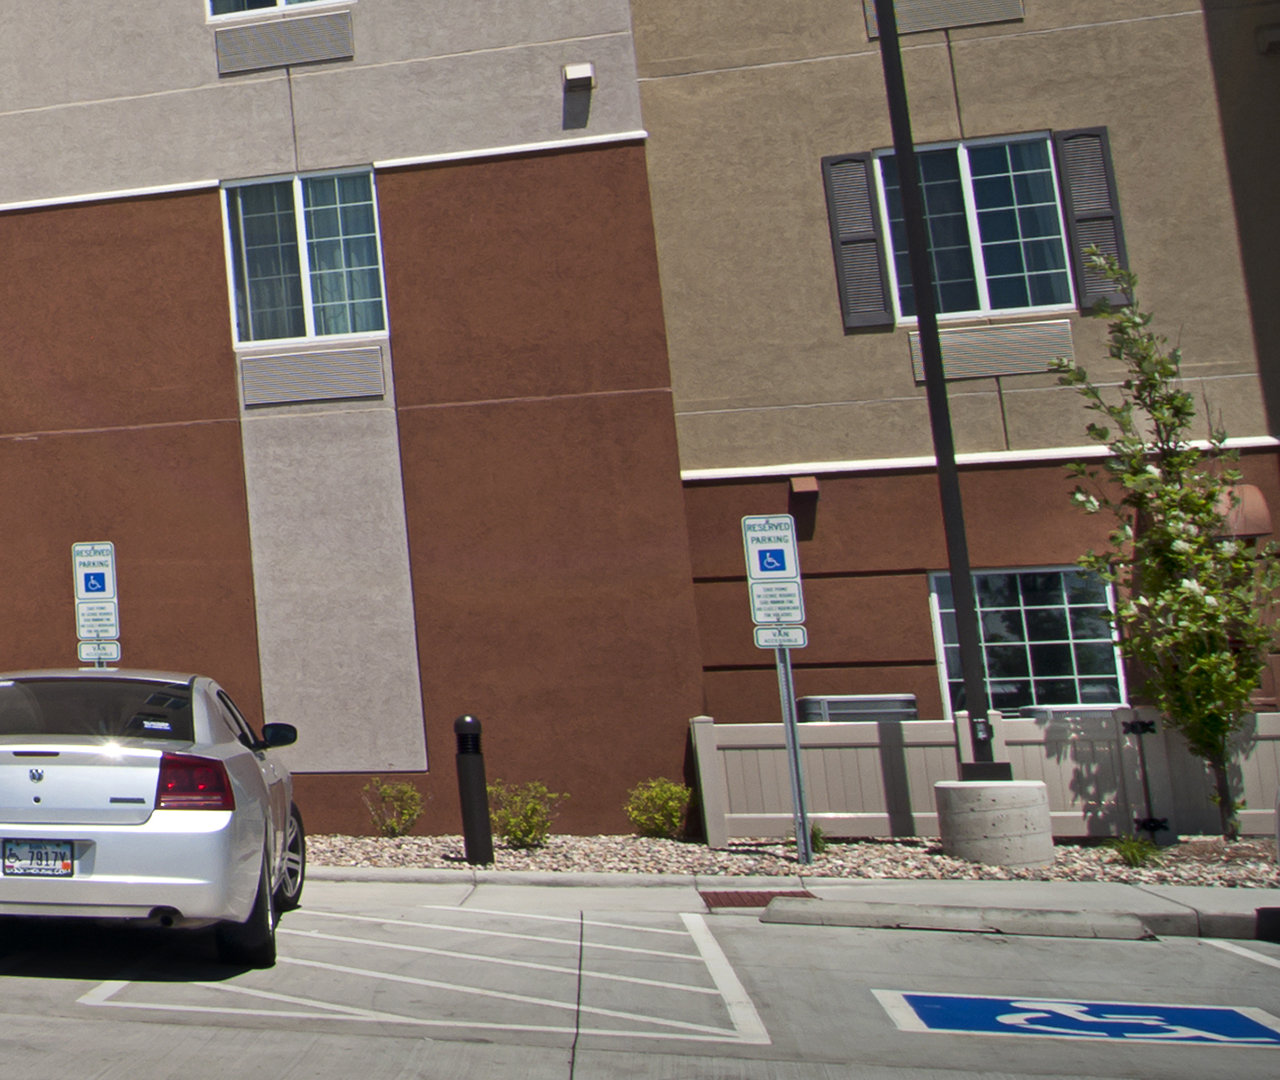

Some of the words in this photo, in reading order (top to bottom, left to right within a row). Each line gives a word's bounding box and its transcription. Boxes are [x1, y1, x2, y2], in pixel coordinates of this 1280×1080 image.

[746, 522, 790, 532] RESERVED
[751, 535, 789, 544] PARKING
[78, 560, 109, 568] PARKING
